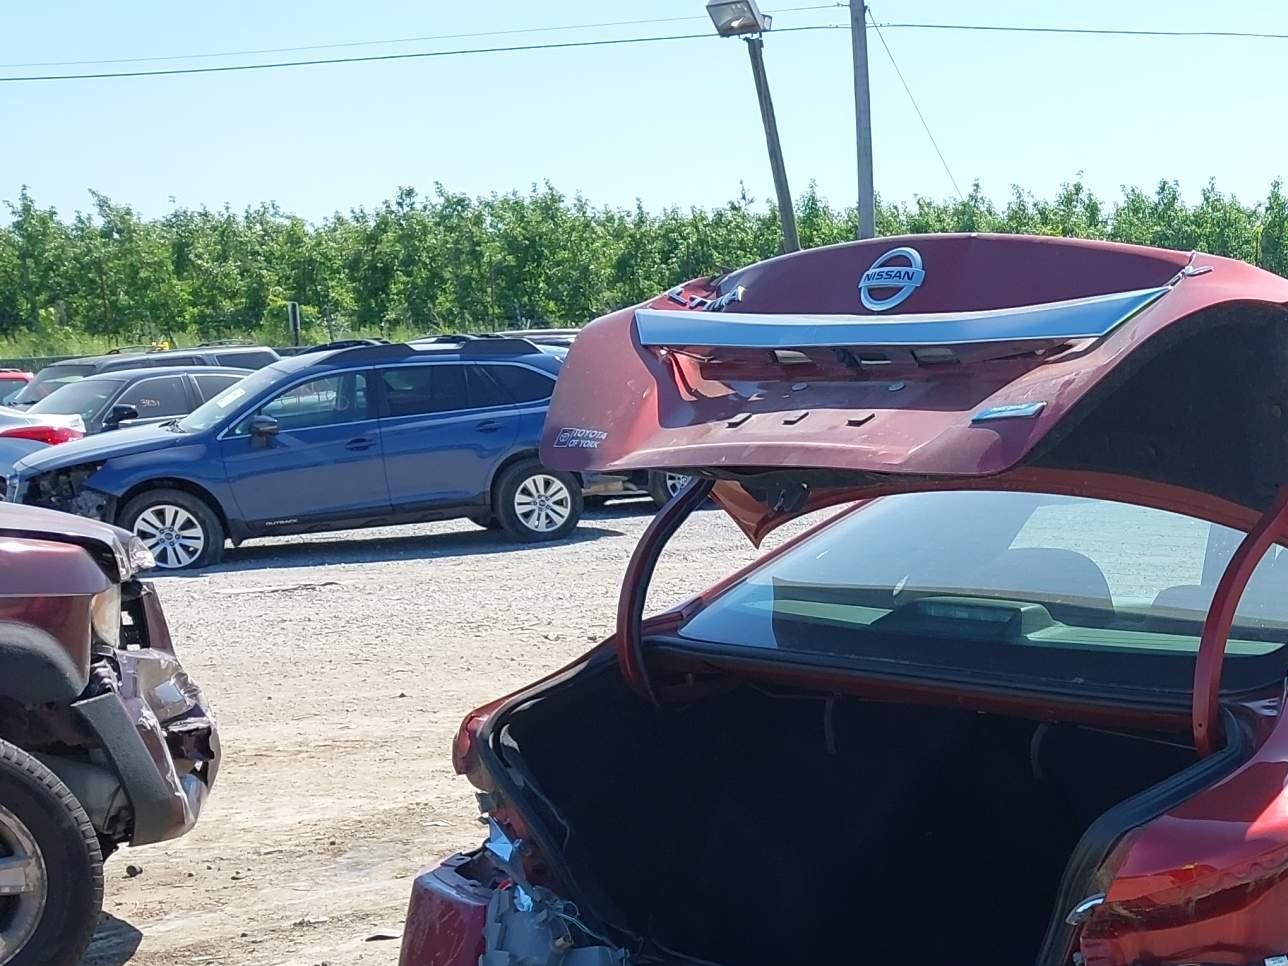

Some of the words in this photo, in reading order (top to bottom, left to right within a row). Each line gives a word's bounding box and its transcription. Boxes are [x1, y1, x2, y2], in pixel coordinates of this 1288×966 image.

[863, 270, 915, 282] NISSAN
[572, 428, 608, 440] TOYOTA
[568, 439, 579, 448] OF
[579, 439, 600, 449] YORK
